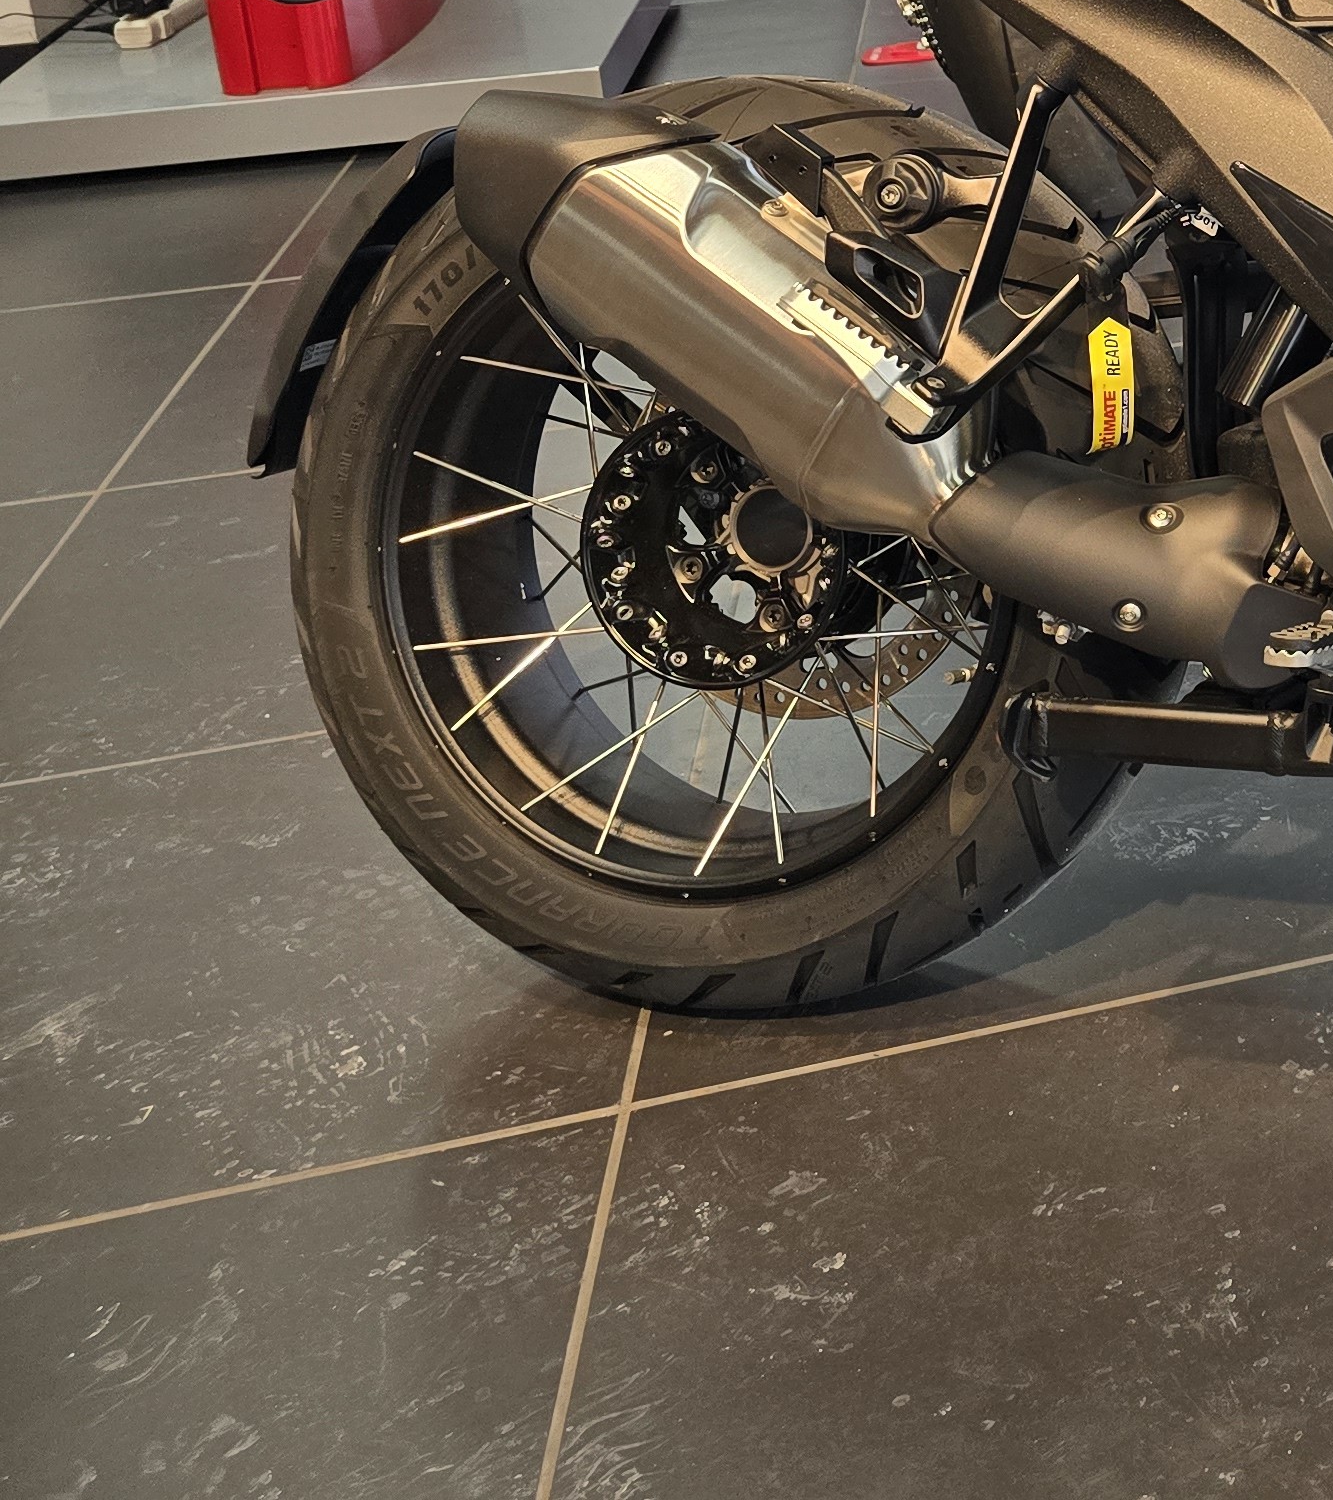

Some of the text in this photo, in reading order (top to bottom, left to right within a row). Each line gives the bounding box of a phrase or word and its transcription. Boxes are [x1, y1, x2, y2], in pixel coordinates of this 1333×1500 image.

[1099, 329, 1121, 449] ptiMATE READY
[352, 699, 450, 824] NEXT
